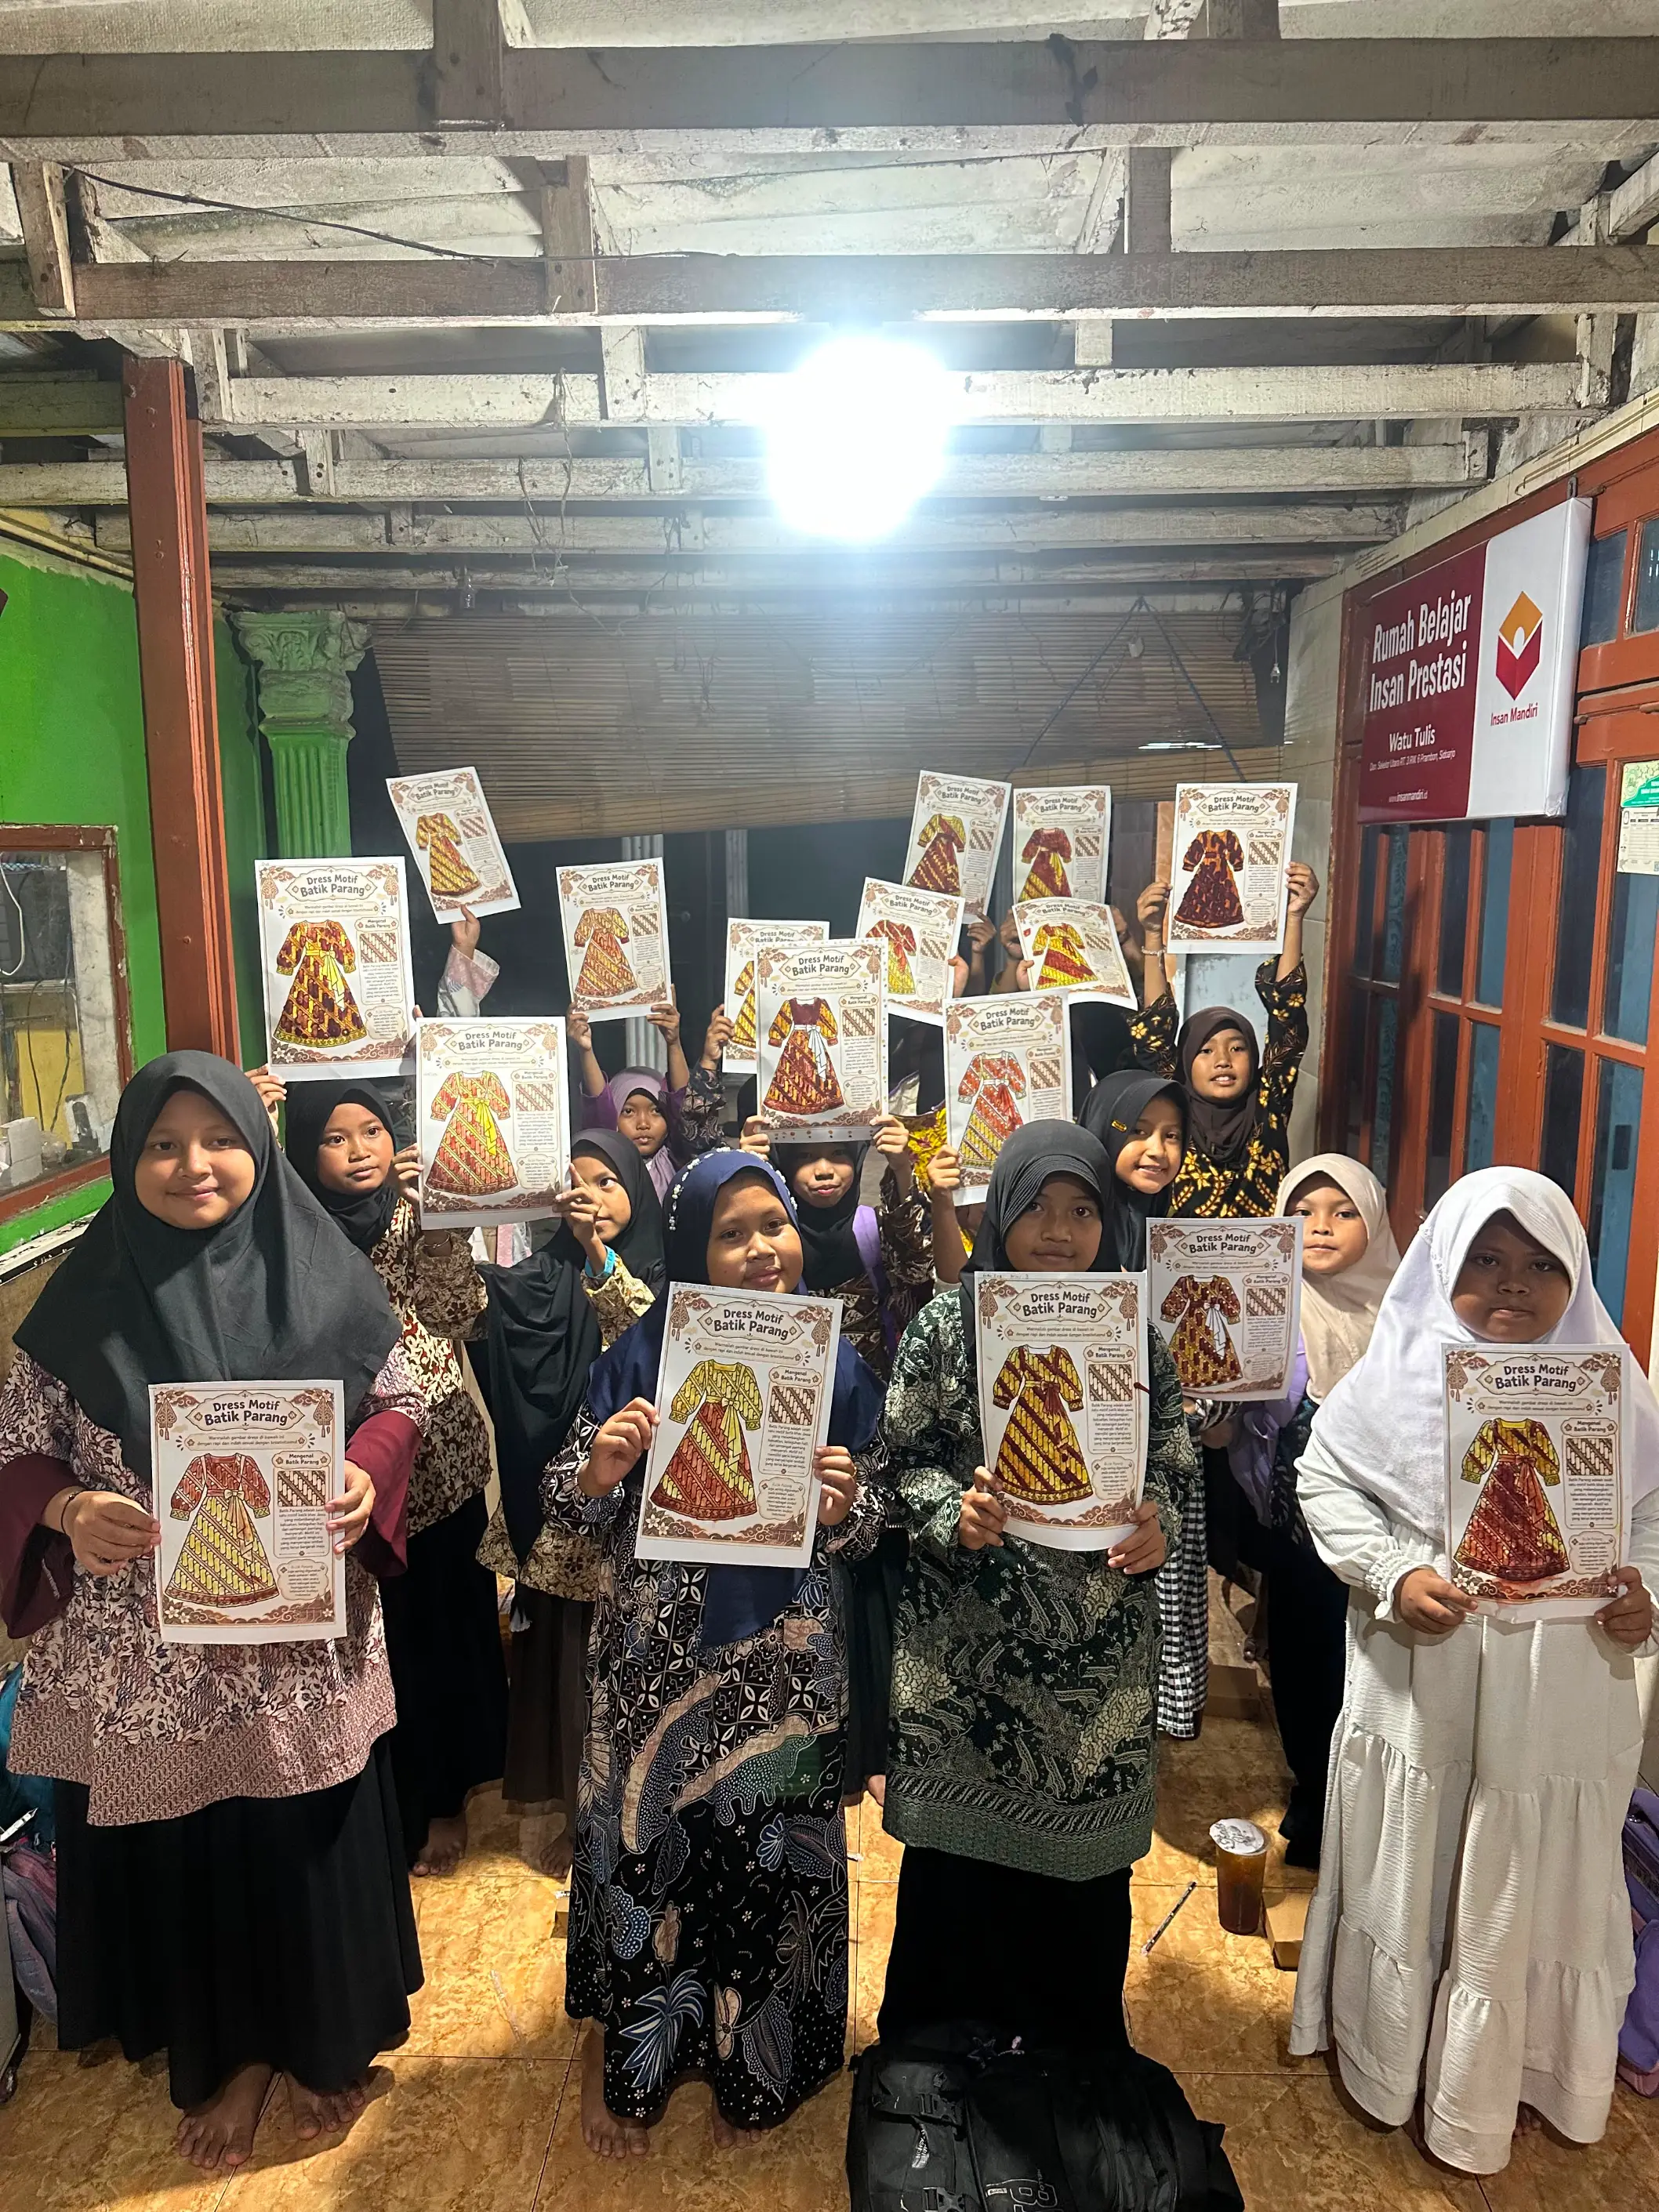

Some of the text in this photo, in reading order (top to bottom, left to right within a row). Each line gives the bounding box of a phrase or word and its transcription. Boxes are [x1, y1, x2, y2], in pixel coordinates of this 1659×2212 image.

[1372, 589, 1471, 664] Rumah Belajar
[1370, 640, 1467, 712] Insan Prestasi
[1490, 702, 1538, 726] Insan Mandiri
[1389, 724, 1436, 752] Watu Tulis
[960, 793, 981, 804] Parang
[1208, 803, 1259, 813] Batik Parang
[307, 875, 358, 885] Dress Motif
[300, 884, 365, 897] Batik Parang
[588, 883, 608, 891] Batik
[910, 903, 932, 915] Parang
[1063, 908, 1085, 916] Parang
[799, 956, 820, 965] Dress
[793, 964, 849, 976] Batik Parang
[986, 1010, 1007, 1019] Dress
[981, 1017, 1035, 1031] Batik Parang
[459, 1039, 522, 1050] Batik Parang
[1189, 1242, 1257, 1254] Batik Parang
[1031, 1291, 1091, 1303] Dress Motif
[724, 1309, 784, 1324] Dress Motif
[1022, 1303, 1097, 1318] Batik Parang
[714, 1319, 789, 1340] Batik Parang
[1504, 1364, 1569, 1376] Dress Motif
[1495, 1376, 1576, 1391] Batik Parang
[213, 1400, 280, 1411] Dress Motif
[205, 1411, 288, 1425] Batik Parang
